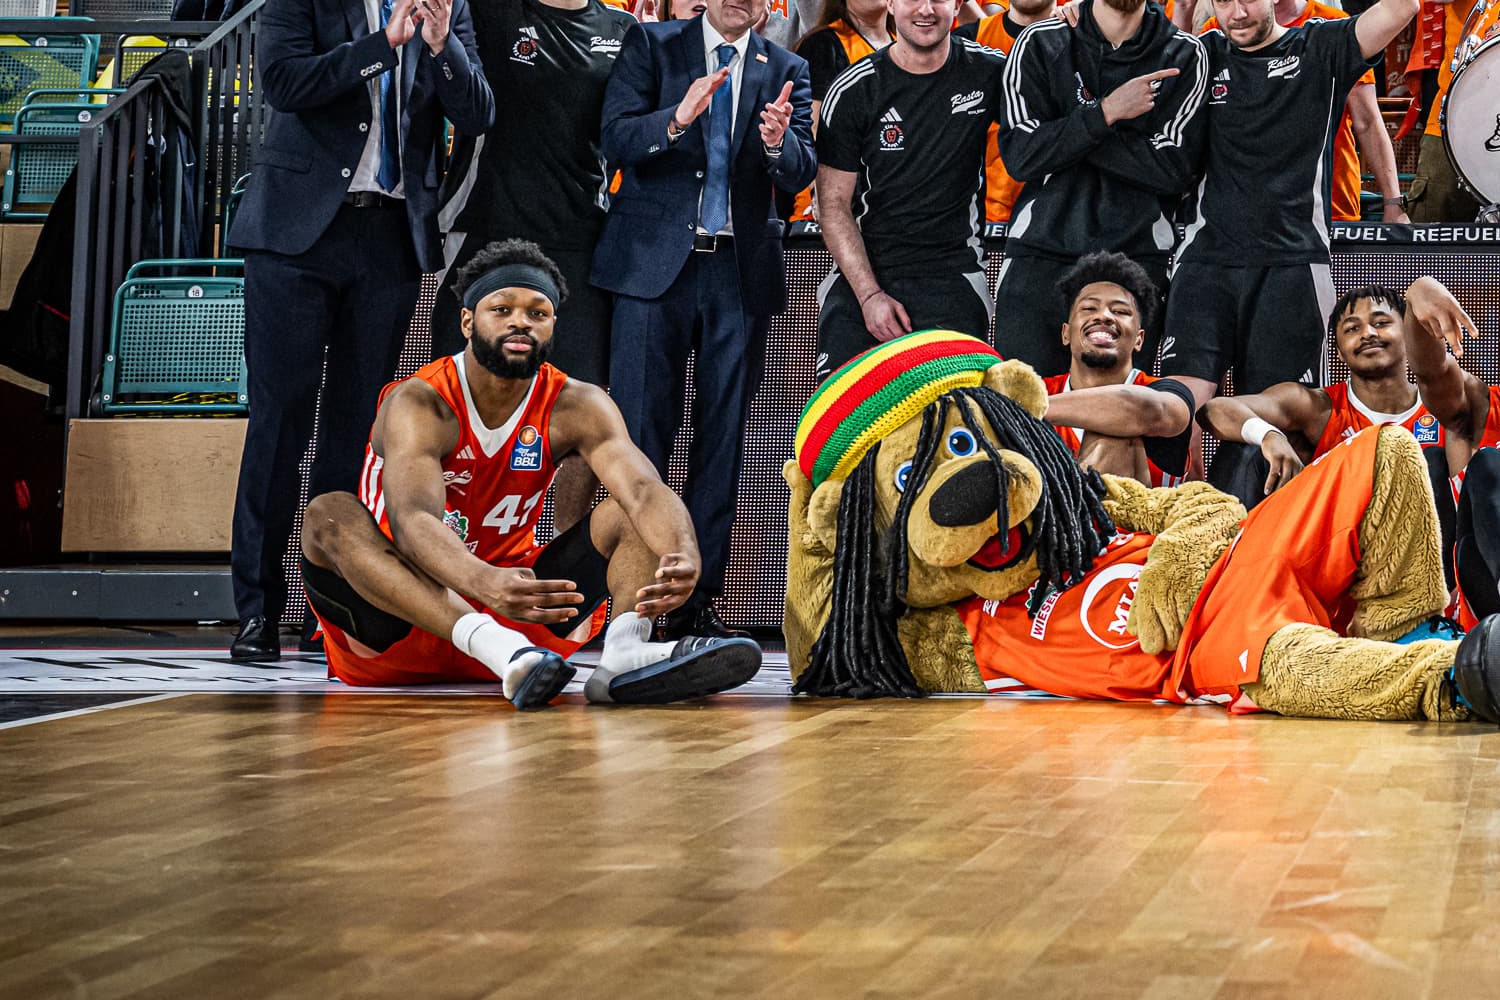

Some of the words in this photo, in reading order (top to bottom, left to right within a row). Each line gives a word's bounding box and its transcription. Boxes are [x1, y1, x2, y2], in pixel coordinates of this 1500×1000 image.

[1267, 56, 1297, 71] Rasta
[951, 90, 985, 107] Rasta
[1416, 430, 1438, 443] BBL
[513, 456, 538, 468] BBL
